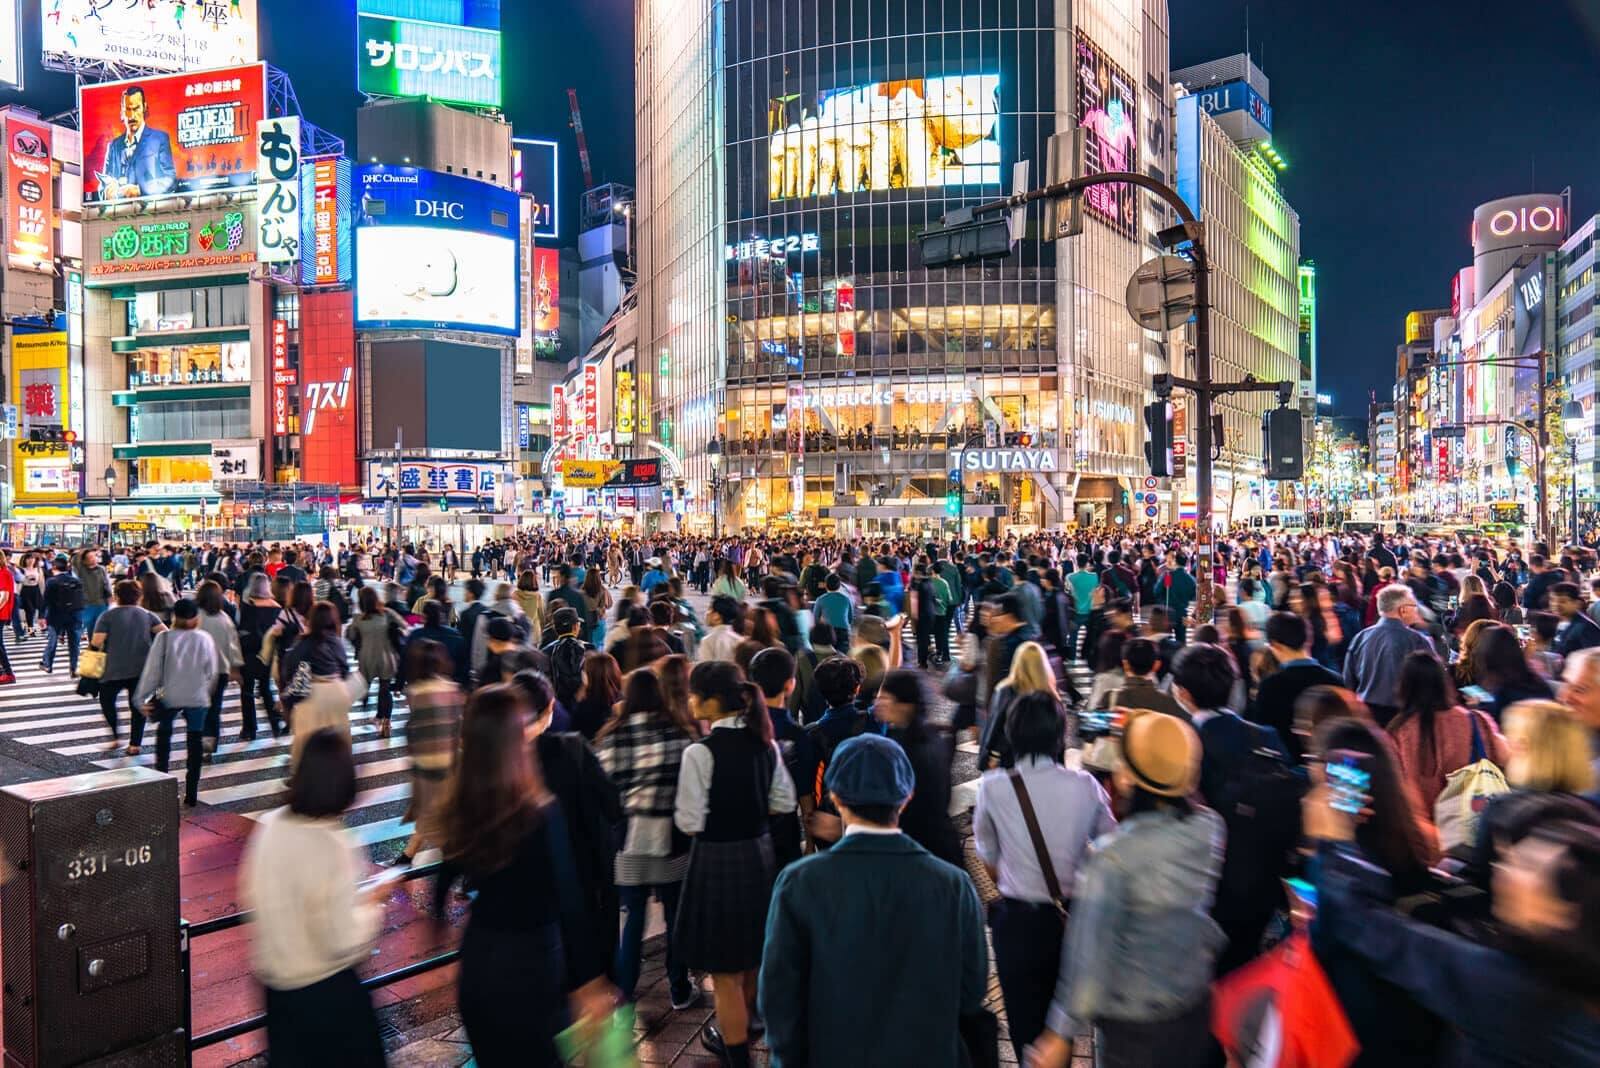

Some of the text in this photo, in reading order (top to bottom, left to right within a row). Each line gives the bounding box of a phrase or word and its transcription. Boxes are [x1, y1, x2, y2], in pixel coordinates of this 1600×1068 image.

[104, 43, 158, 60] 2018.10.24
[159, 51, 177, 62] ON
[365, 38, 495, 80] サロンパス
[178, 111, 202, 130] RED
[202, 107, 234, 128] DEAD
[260, 121, 299, 258] もんじゃ
[362, 174, 419, 184] DHC Channel
[315, 164, 333, 277] 三千里薬品
[414, 199, 464, 220] DHC
[140, 230, 189, 257] 西村
[142, 372, 218, 385] Euphoria
[25, 383, 56, 416] 薬
[304, 366, 353, 436] クスリ
[790, 387, 973, 409] STARBUCKS COFFEE
[1506, 430, 1515, 457] ZARA
[950, 451, 1055, 470] TSUTAYA
[376, 467, 496, 492] 大盛堂書店
[67, 844, 151, 880] 331-06
